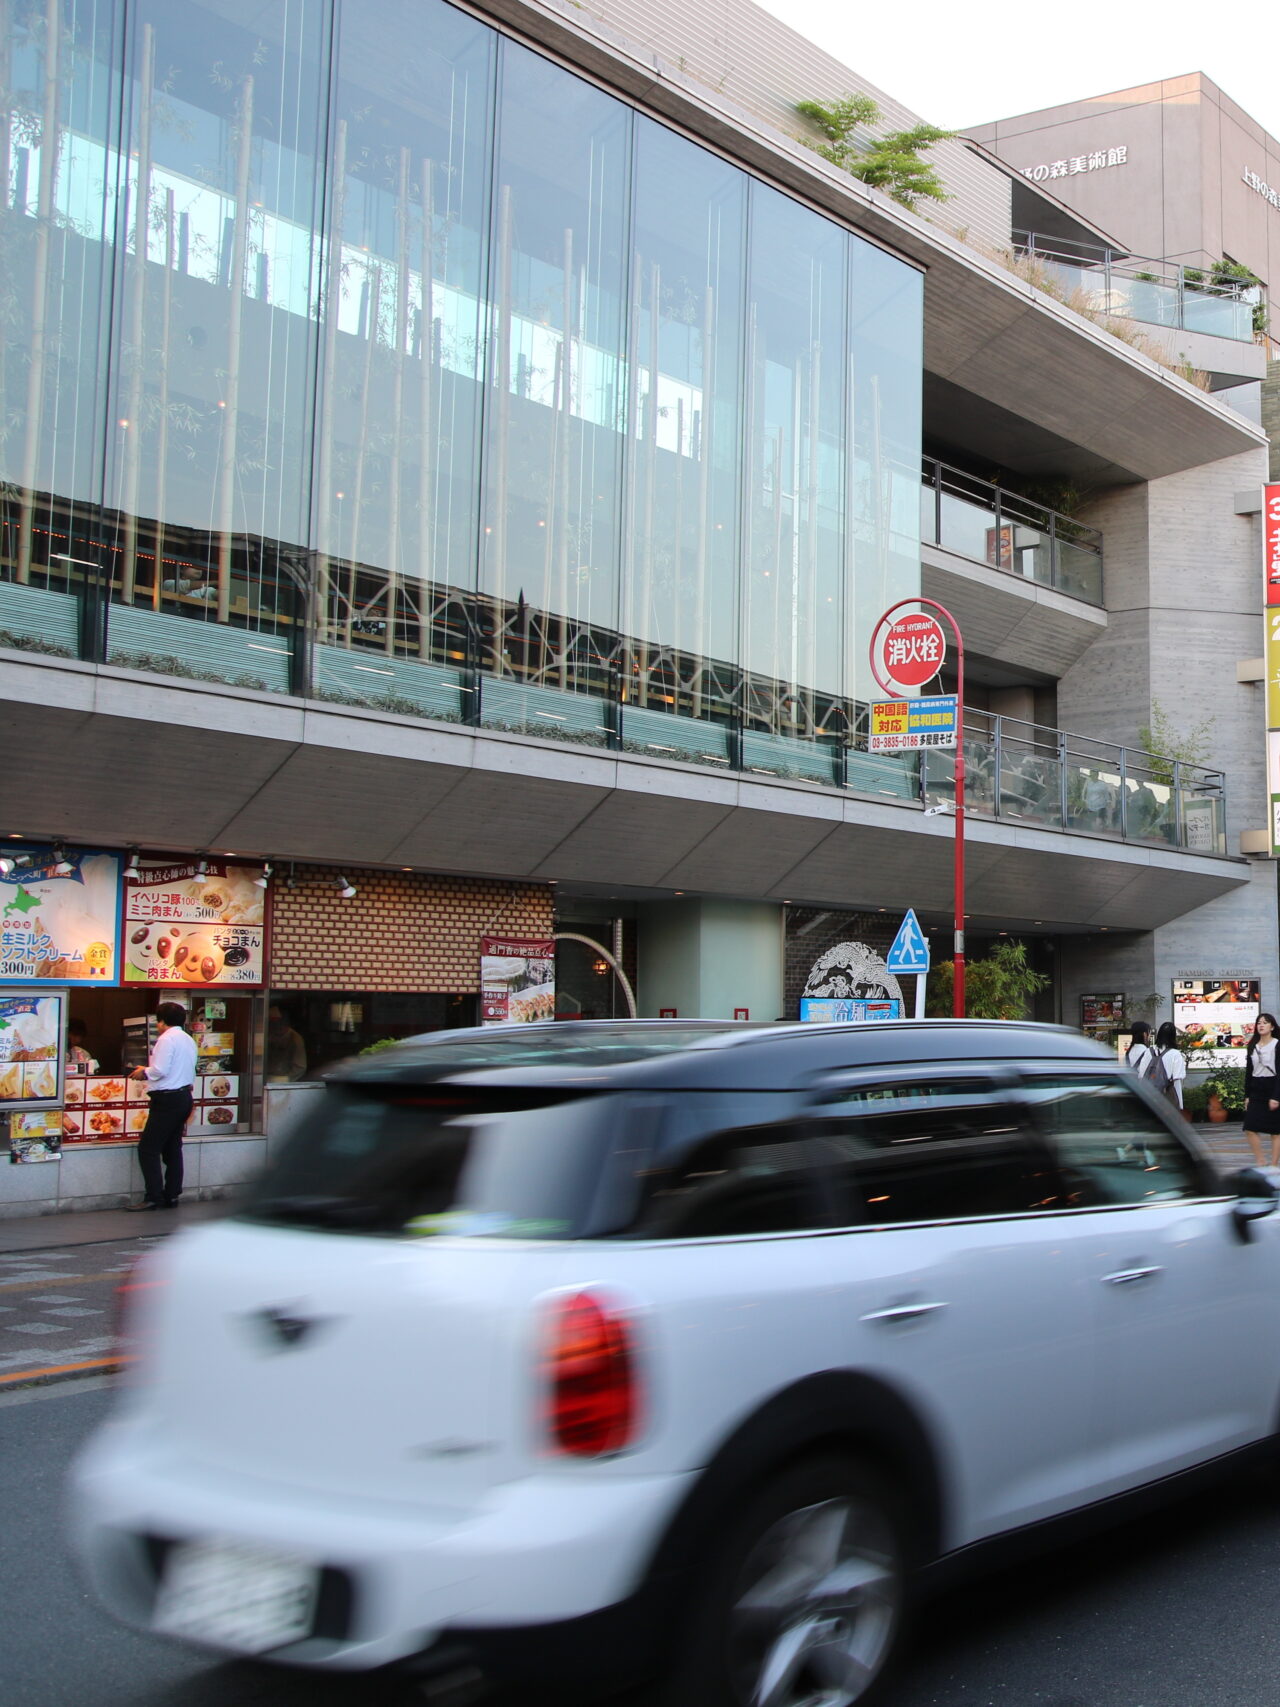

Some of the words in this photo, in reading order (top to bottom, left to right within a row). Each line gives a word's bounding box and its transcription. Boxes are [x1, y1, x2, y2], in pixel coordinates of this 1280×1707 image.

[892, 625, 905, 633] FIRE
[907, 621, 934, 631] HYDRANT
[888, 634, 940, 666] 消火栓
[873, 704, 908, 717] 中国語
[878, 719, 902, 732] 対応
[131, 904, 182, 917] ミニ肉まん
[1, 932, 51, 946] 生ミルク
[213, 935, 260, 947] チョコまん
[1, 947, 83, 960] ソフトクリーム
[0, 962, 34, 975] 300円
[147, 968, 180, 979] 肉まん
